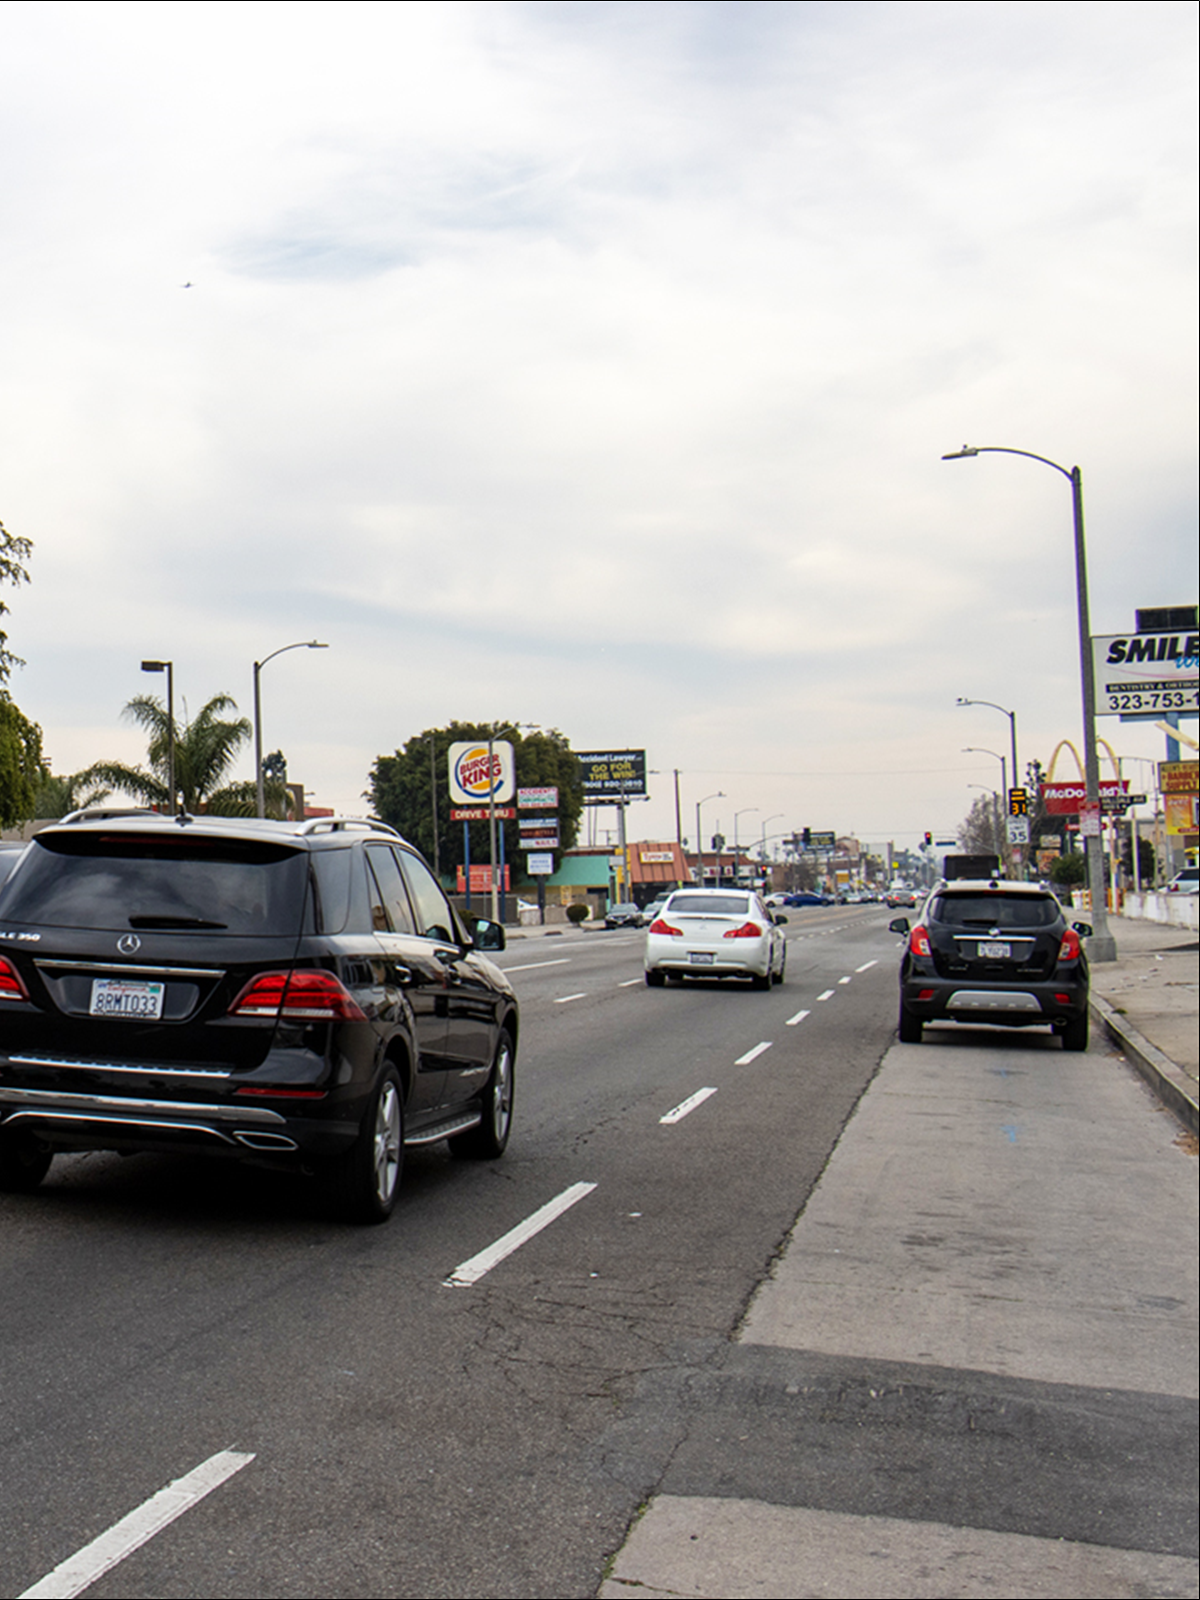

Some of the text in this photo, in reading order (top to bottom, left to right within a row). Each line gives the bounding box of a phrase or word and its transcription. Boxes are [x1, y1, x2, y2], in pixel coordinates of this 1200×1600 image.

[1106, 636, 1199, 664] SMILE
[1109, 683, 1156, 692] DENTISTRY
[1157, 682, 1164, 690] &
[591, 761, 632, 774] GO FOR
[462, 763, 502, 788] KING
[588, 772, 610, 781] THE
[455, 808, 481, 819] DRIVE
[1012, 803, 1026, 815] 31
[1010, 831, 1027, 842] 35
[17, 932, 41, 942] 350
[107, 984, 148, 994] California
[96, 993, 158, 1013] 8RMT033
